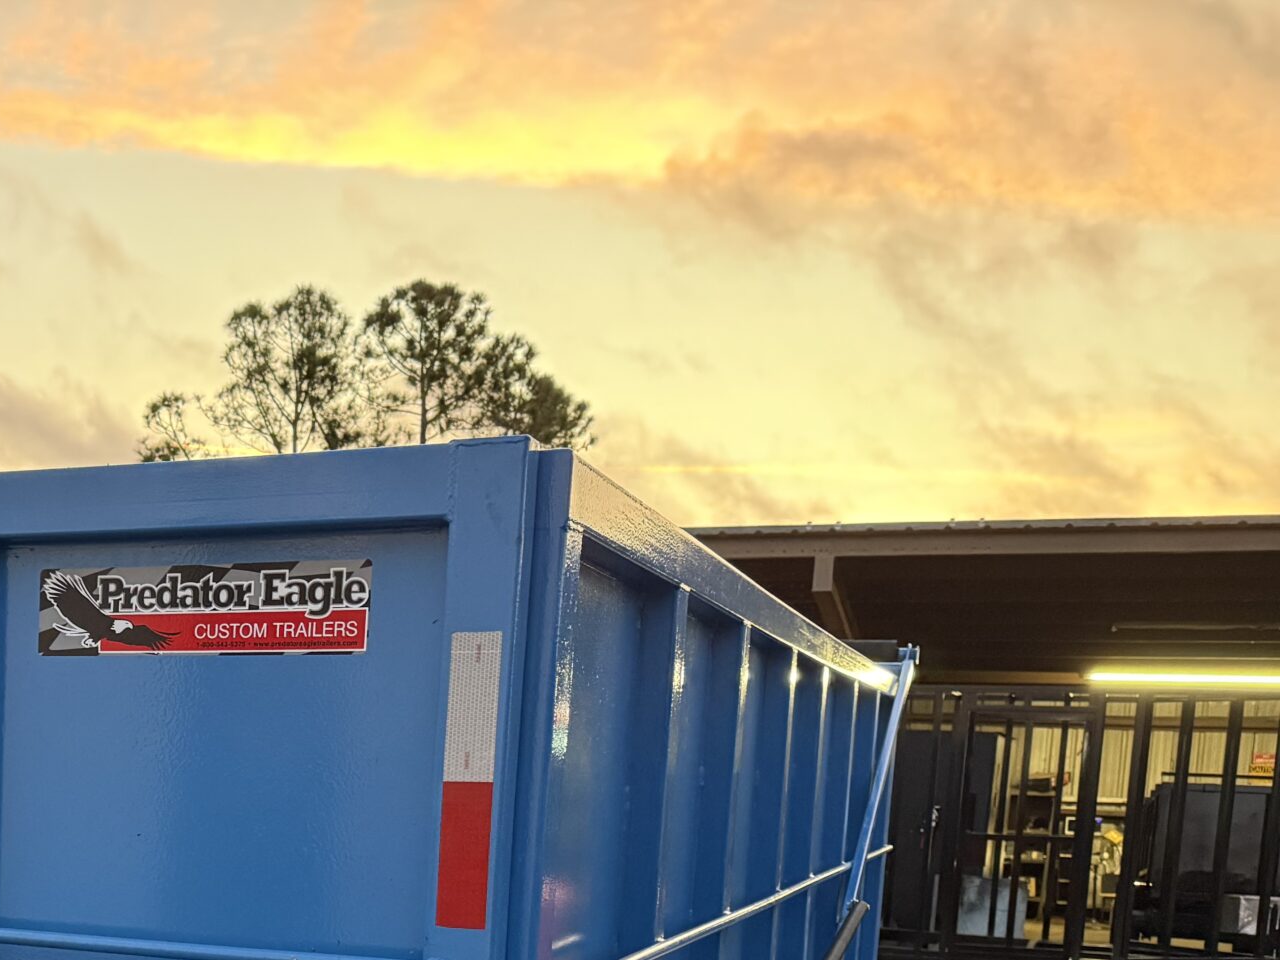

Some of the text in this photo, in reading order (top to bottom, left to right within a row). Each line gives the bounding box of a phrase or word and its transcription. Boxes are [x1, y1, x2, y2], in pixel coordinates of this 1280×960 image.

[98, 569, 368, 617] Predator Eagle
[194, 620, 359, 640] CUSTOM TRAILERS
